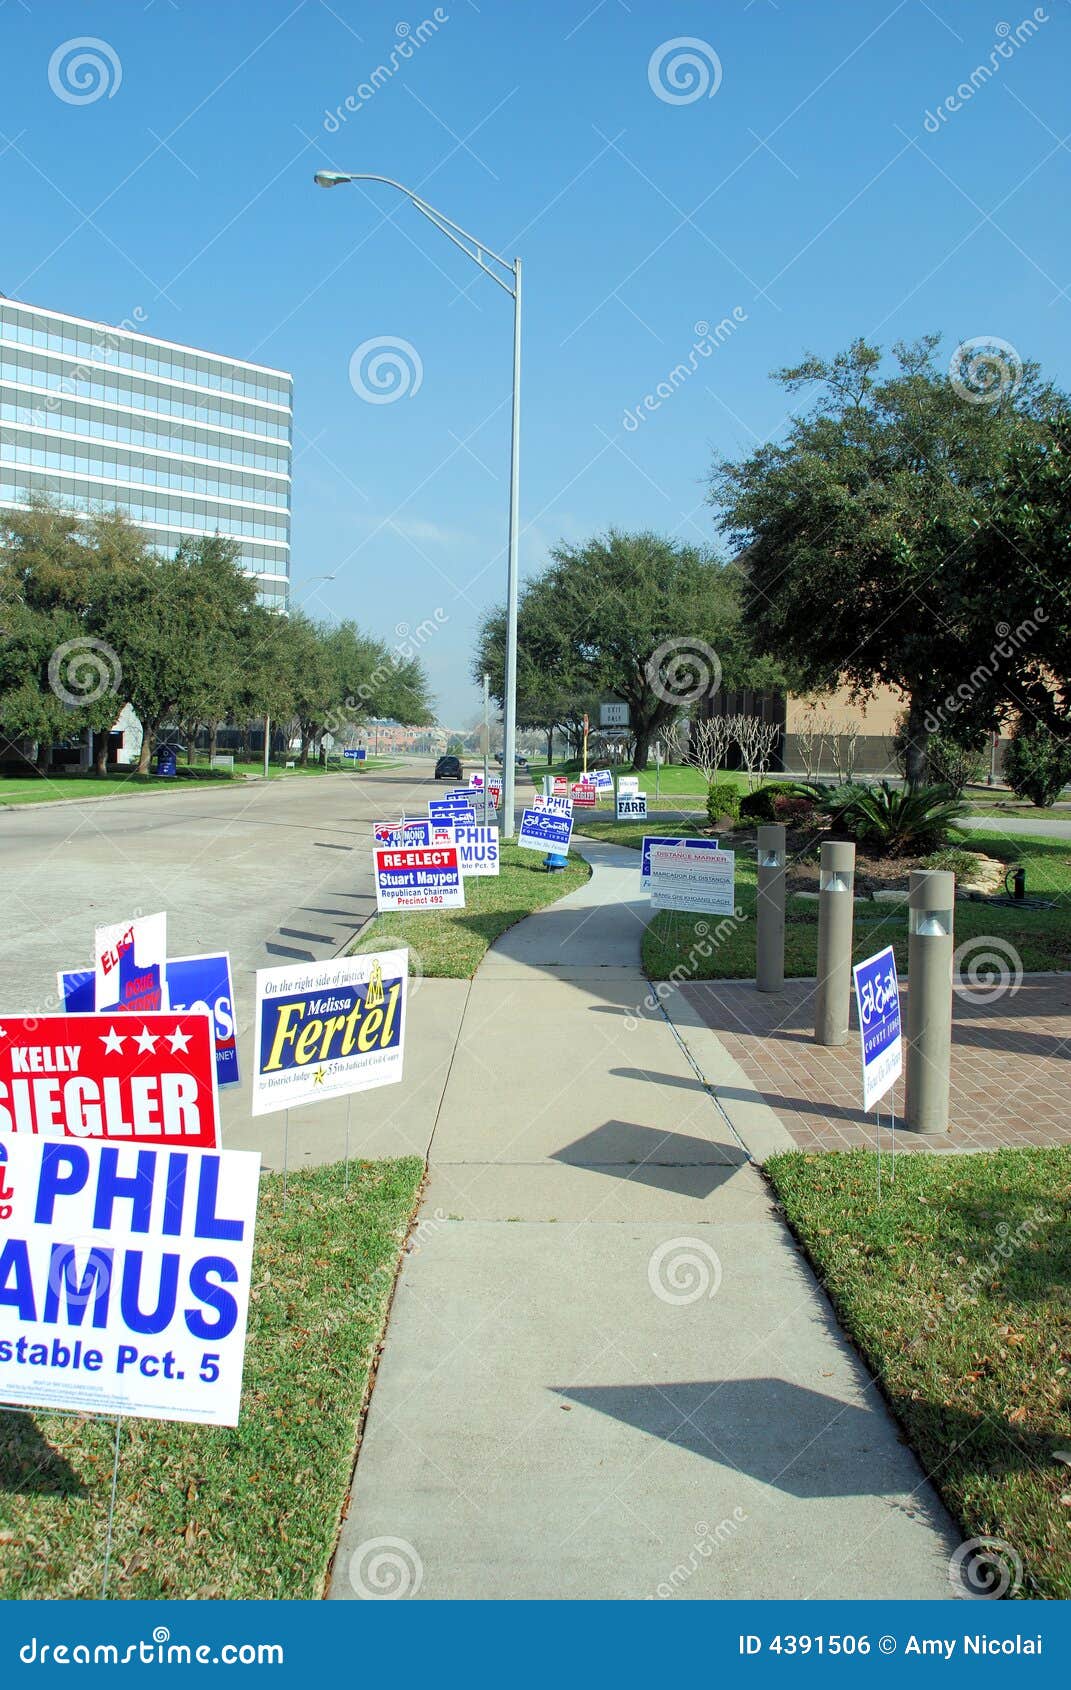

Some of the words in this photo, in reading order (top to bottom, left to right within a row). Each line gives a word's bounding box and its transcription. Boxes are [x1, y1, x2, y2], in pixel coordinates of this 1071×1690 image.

[546, 798, 572, 810] PHIL
[618, 801, 646, 813] FARR
[455, 827, 496, 843] PHIL
[383, 851, 450, 867] RE-ELECT
[656, 850, 691, 860] DISTANCE
[694, 854, 727, 863] MARKER
[379, 872, 414, 886] Stuart
[417, 871, 458, 886] Mayper
[653, 870, 688, 880] MARCADOR
[381, 888, 422, 898] Republican
[423, 887, 458, 896] Chairman
[397, 896, 428, 905] Precinct
[430, 896, 443, 904] 492
[101, 926, 135, 976] ELECT
[265, 981, 277, 994] On
[279, 978, 292, 991] the
[294, 976, 314, 993] right
[315, 973, 331, 987] side
[332, 971, 340, 985] of
[340, 970, 365, 985] justice
[307, 996, 351, 1016] Melissa
[263, 983, 401, 1072] Fertel
[865, 1029, 886, 1054] COUNTY
[11, 1046, 81, 1072] KELLY
[268, 1075, 292, 1088] District
[292, 1072, 311, 1084] Judge
[326, 1061, 345, 1076] 55th
[344, 1059, 368, 1071] Judicial
[34, 1142, 245, 1241] PHIL
[116, 1344, 185, 1380] Pct.
[199, 1352, 221, 1383] 5
